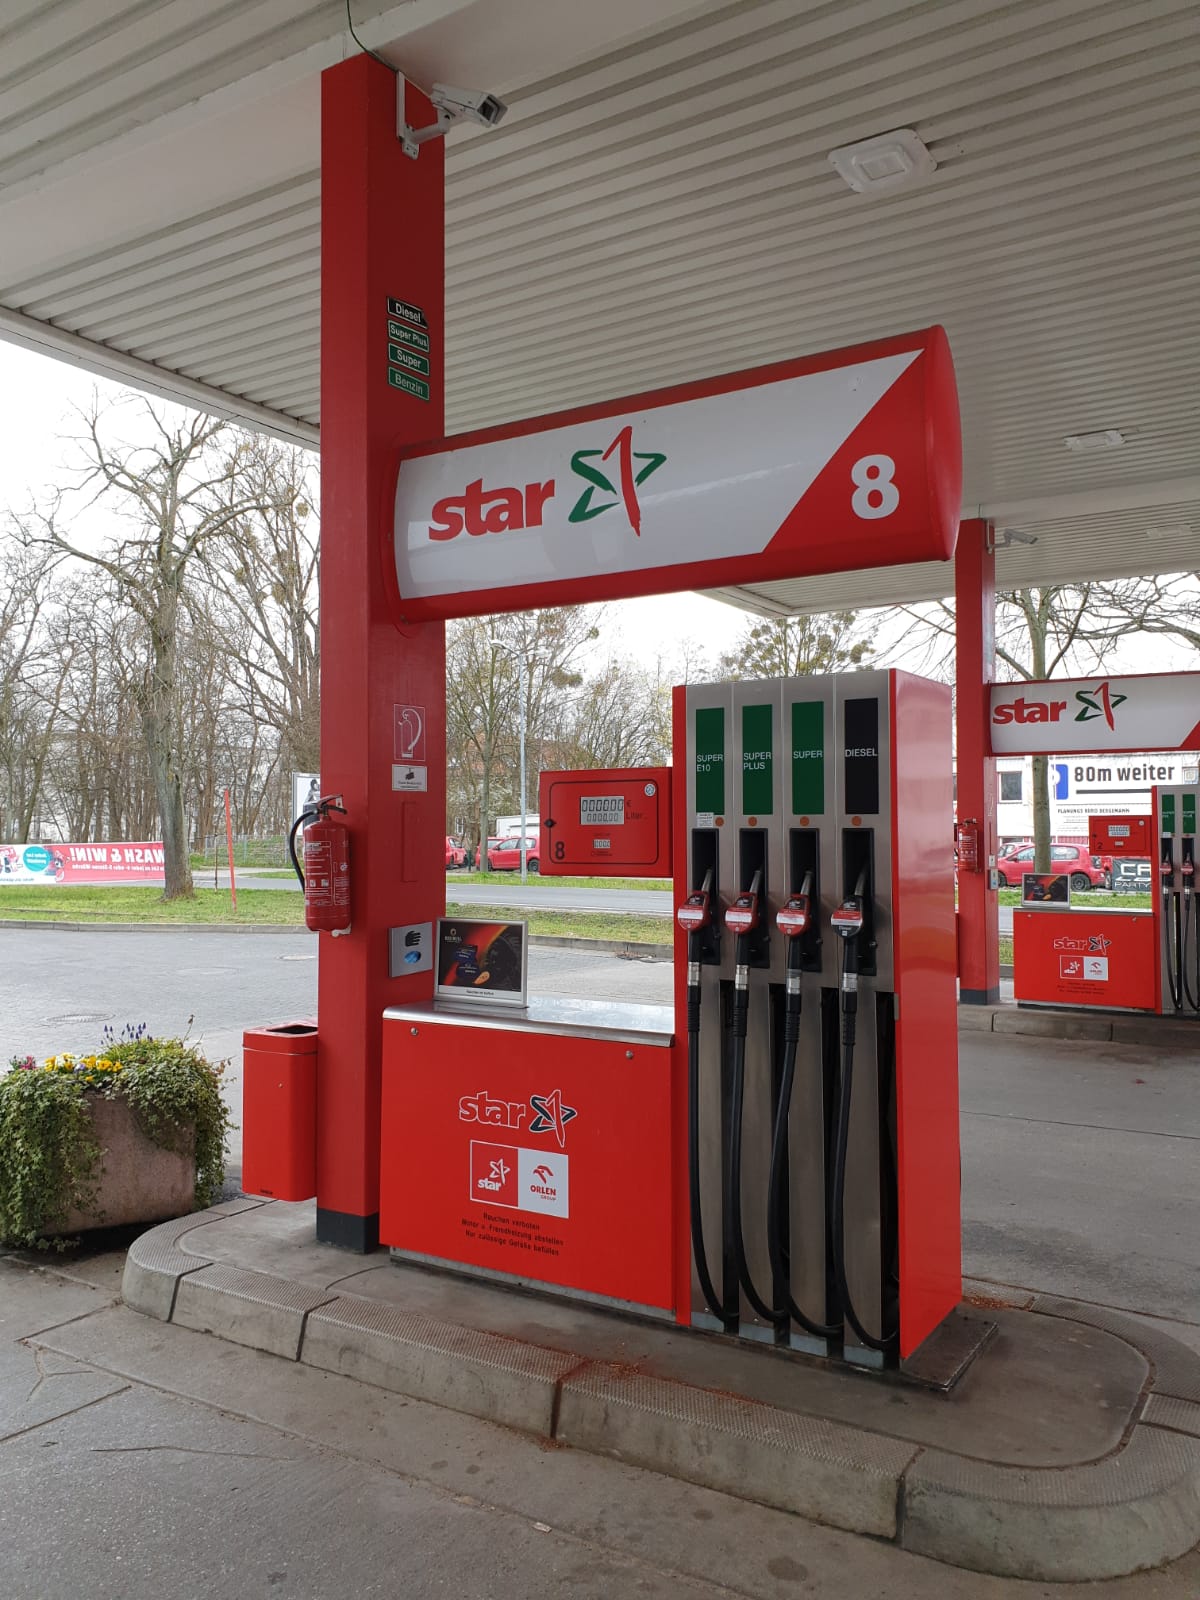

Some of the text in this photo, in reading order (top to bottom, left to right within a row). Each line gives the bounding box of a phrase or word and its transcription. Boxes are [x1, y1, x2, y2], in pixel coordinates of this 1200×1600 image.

[395, 302, 421, 322] Diesel
[390, 324, 428, 347] Super Plus
[396, 349, 422, 368] Super
[395, 373, 423, 395] Benzin
[851, 454, 899, 520] 8
[429, 477, 555, 541] star
[992, 697, 1067, 725] star
[696, 754, 724, 763] SUPER
[743, 751, 772, 761] SUPER
[793, 750, 823, 760] SUPER
[845, 748, 878, 758] DIESEL
[696, 764, 711, 772] E10
[743, 761, 766, 770] PLUS
[1074, 763, 1175, 782] 80m weiter
[555, 841, 565, 860] 8
[1054, 936, 1088, 950] star
[459, 1091, 526, 1129] star
[477, 1178, 502, 1191] star
[530, 1184, 556, 1196] ORLEN
[483, 1211, 540, 1231] Rauchen verboten
